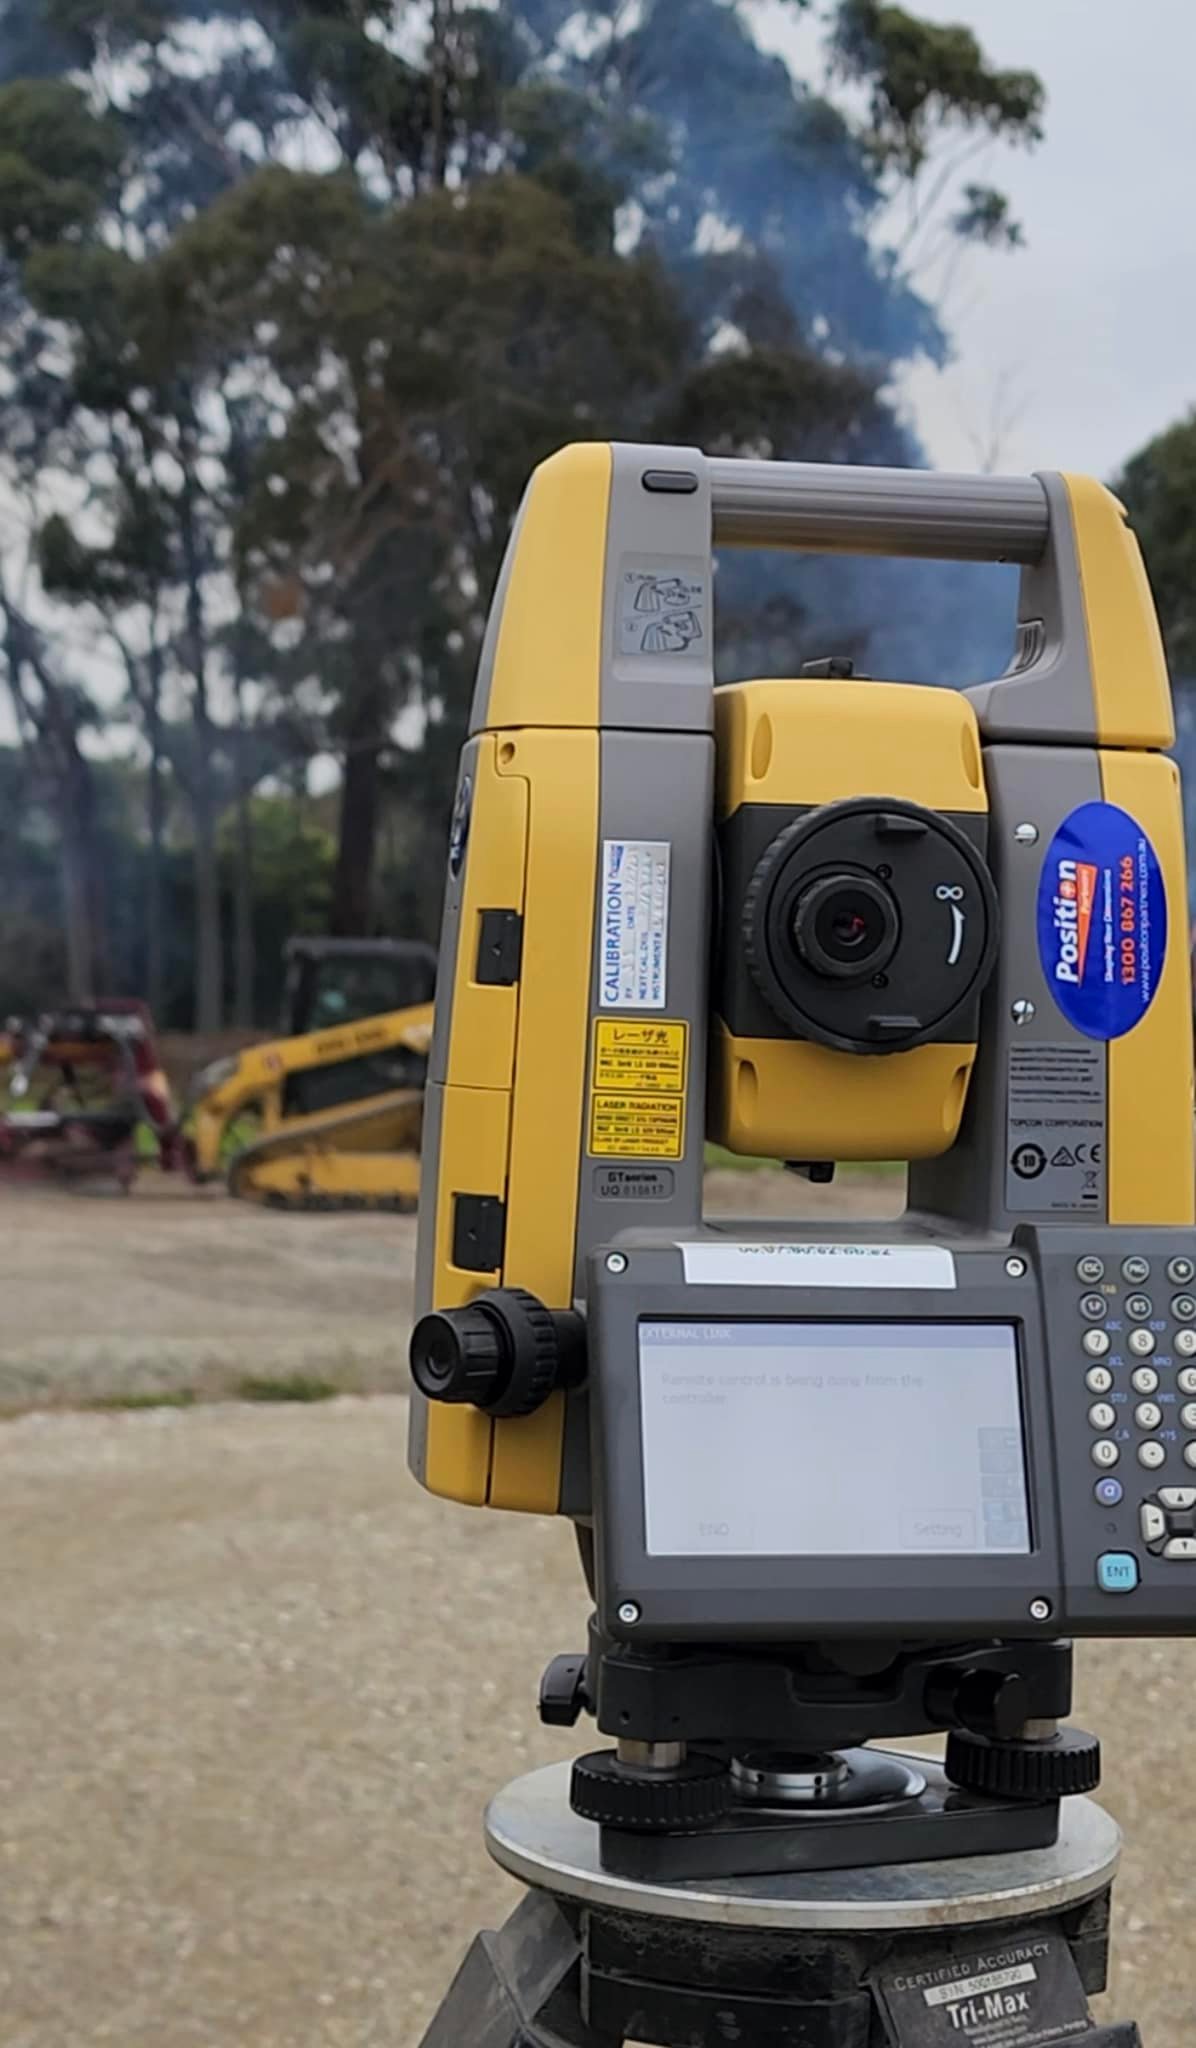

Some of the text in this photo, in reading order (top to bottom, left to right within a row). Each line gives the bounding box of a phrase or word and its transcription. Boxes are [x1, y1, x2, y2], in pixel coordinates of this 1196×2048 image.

[1053, 859, 1079, 983] Position
[1120, 856, 1136, 985] 1300 867 266
[605, 882, 622, 1002] CALIBRATION
[1092, 1334, 1102, 1348] 7
[1138, 1334, 1148, 1348] 8
[1183, 1334, 1194, 1348] 9
[1095, 1372, 1105, 1386] 4
[1142, 1373, 1152, 1387] 5
[1099, 1409, 1106, 1422] 1
[1143, 1407, 1153, 1421] 2
[1102, 1445, 1112, 1459] 0
[1107, 1566, 1130, 1577] ENT
[894, 1943, 1050, 1991] CERTIFIED ACCURACY
[945, 1992, 1030, 2029] Tri-Max
